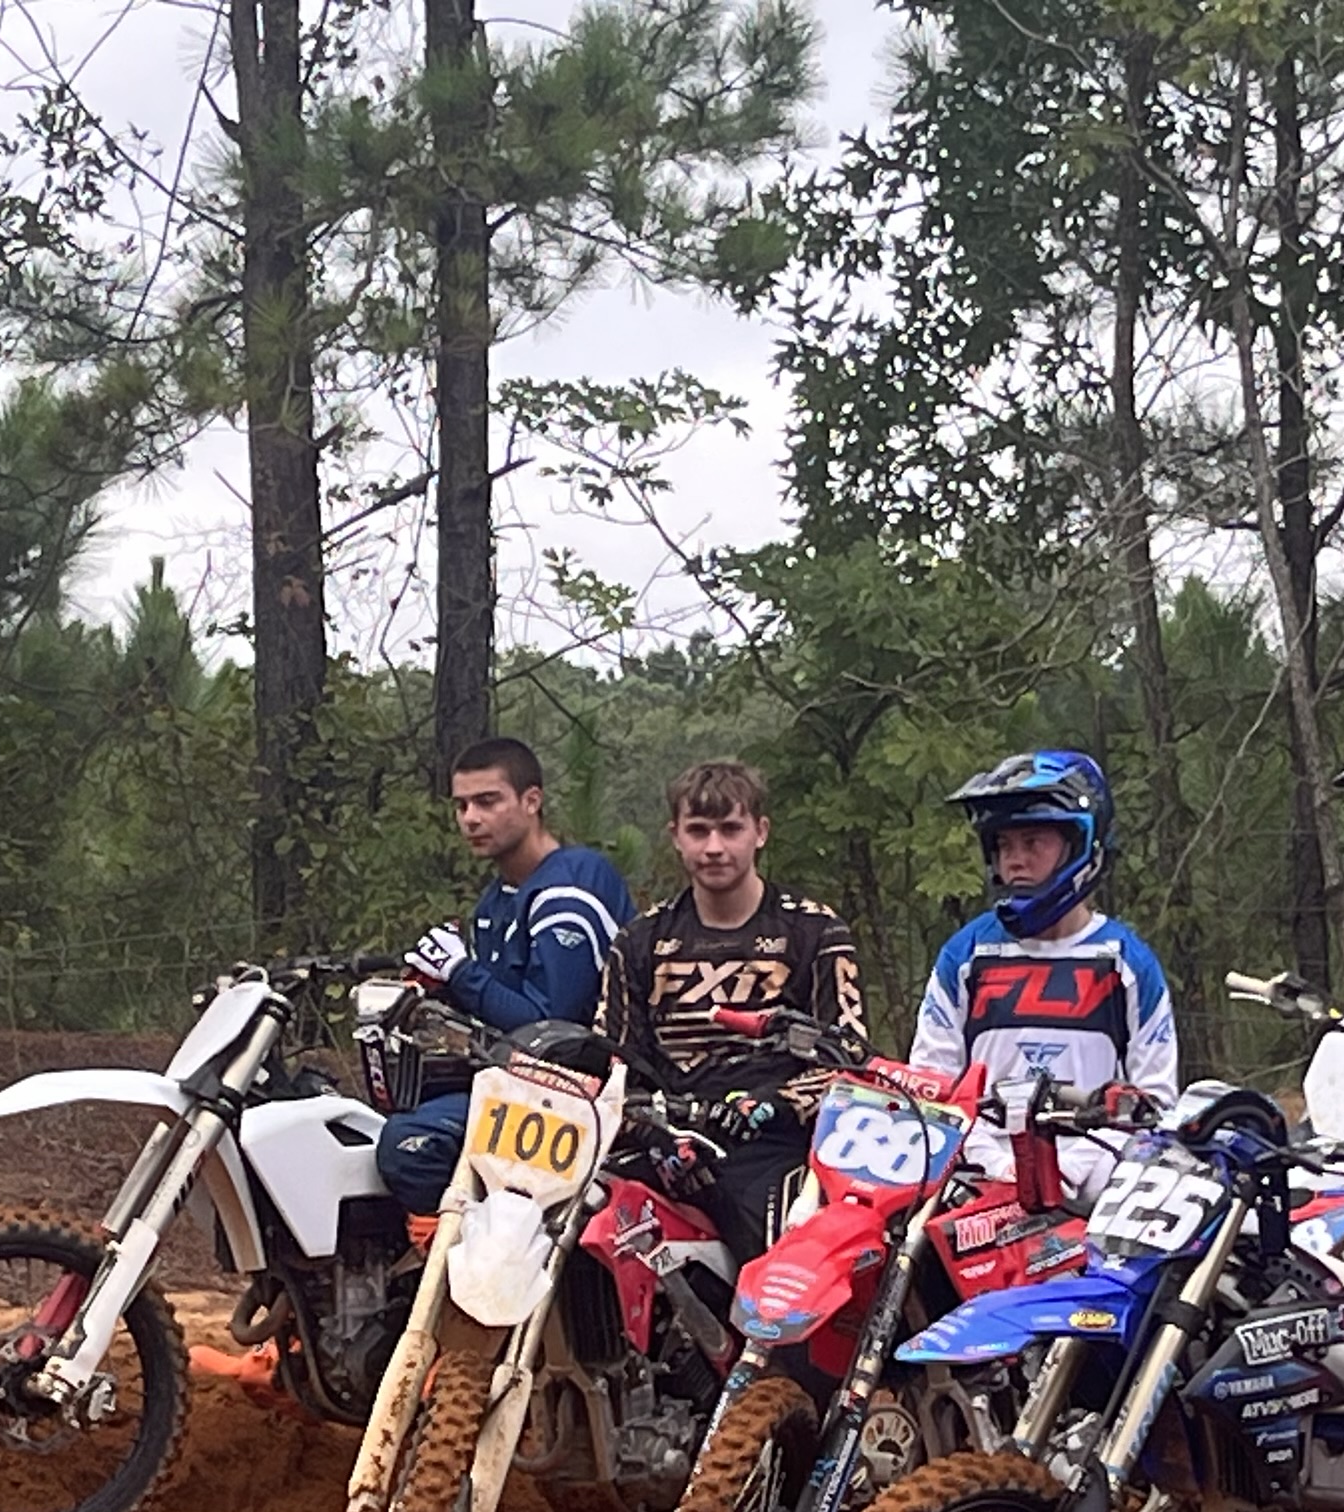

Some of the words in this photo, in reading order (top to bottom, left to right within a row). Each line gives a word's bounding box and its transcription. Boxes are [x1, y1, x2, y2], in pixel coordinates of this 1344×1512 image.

[647, 960, 791, 1006] FXR
[971, 964, 1121, 1019] FLY
[487, 1103, 579, 1174] 100
[816, 1105, 946, 1184] 88
[1086, 1161, 1224, 1251] 225
[1244, 1314, 1327, 1358] Muc-Off
